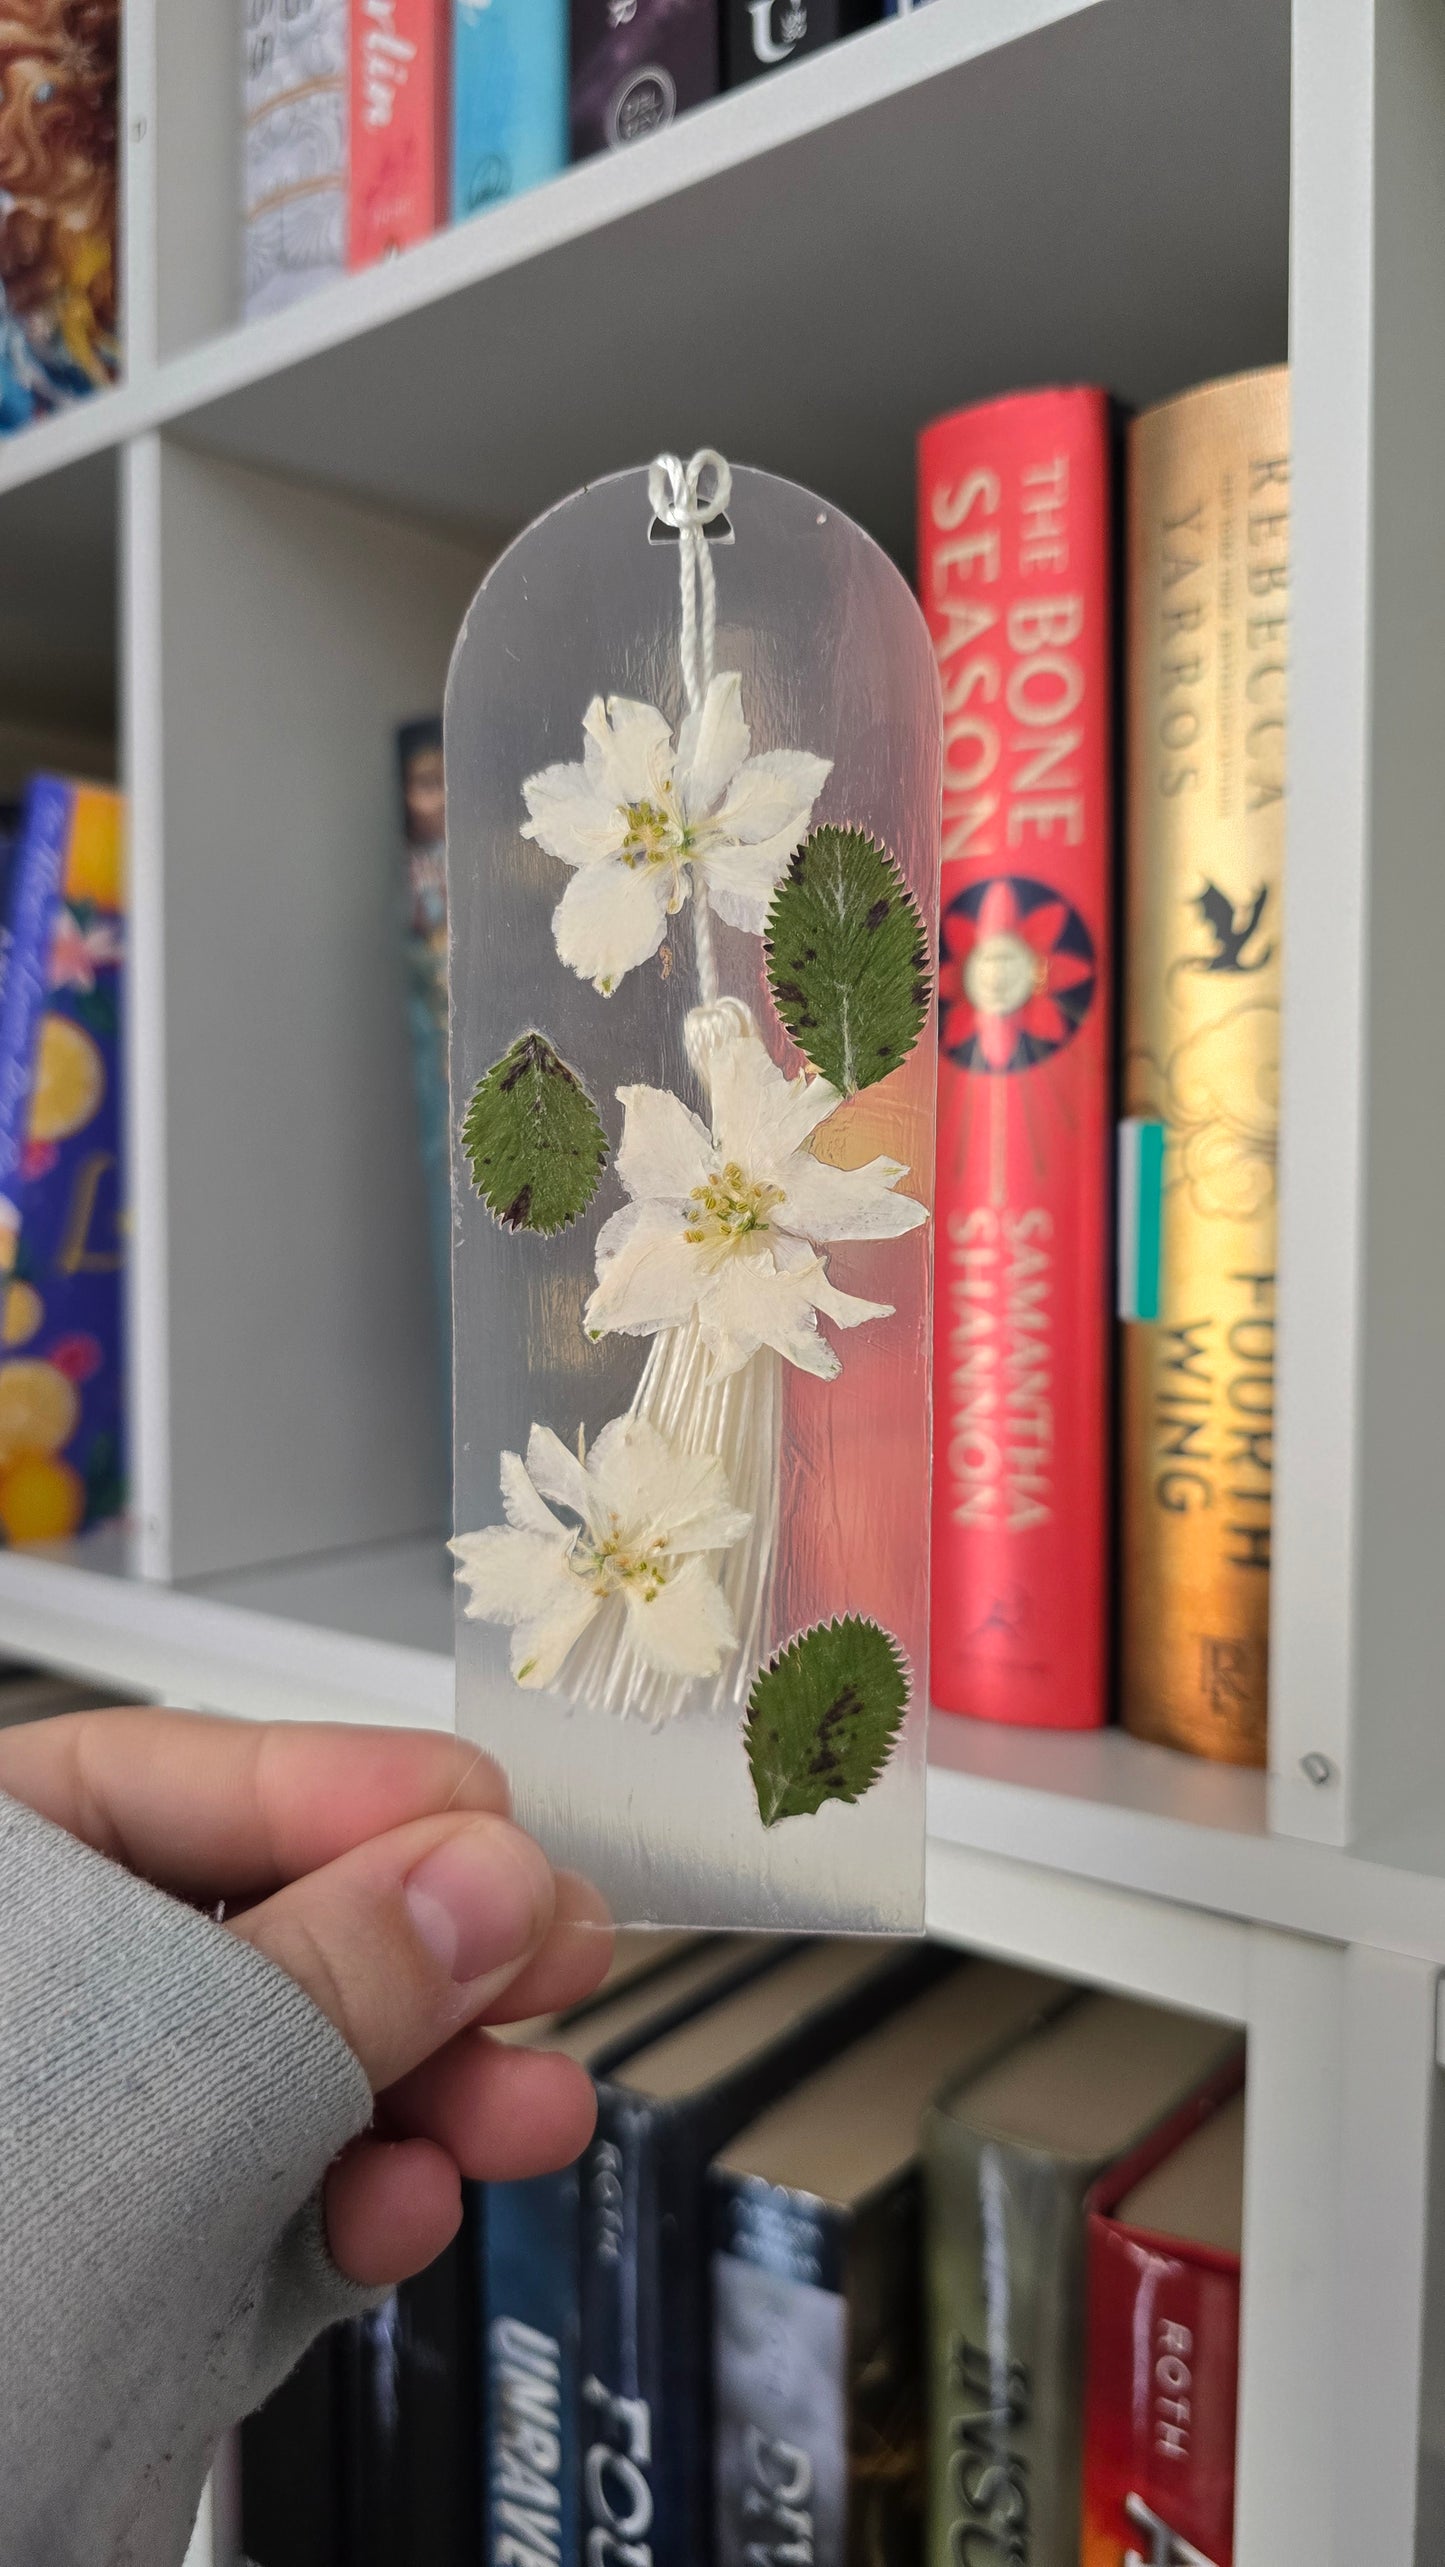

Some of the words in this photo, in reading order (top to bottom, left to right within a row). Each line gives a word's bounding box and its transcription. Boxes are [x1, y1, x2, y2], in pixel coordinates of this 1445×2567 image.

[1018, 453, 1071, 576] THE
[1159, 502, 1205, 798] YARROS
[1246, 458, 1291, 814] REBECCA
[933, 467, 1000, 862] SEASON
[1005, 592, 1086, 850] BONE
[948, 1206, 1002, 1530] SHANNON
[1003, 1206, 1055, 1533] SAMANTHA
[1155, 1317, 1214, 1515] WING
[1154, 2316, 1194, 2459] ROTH
